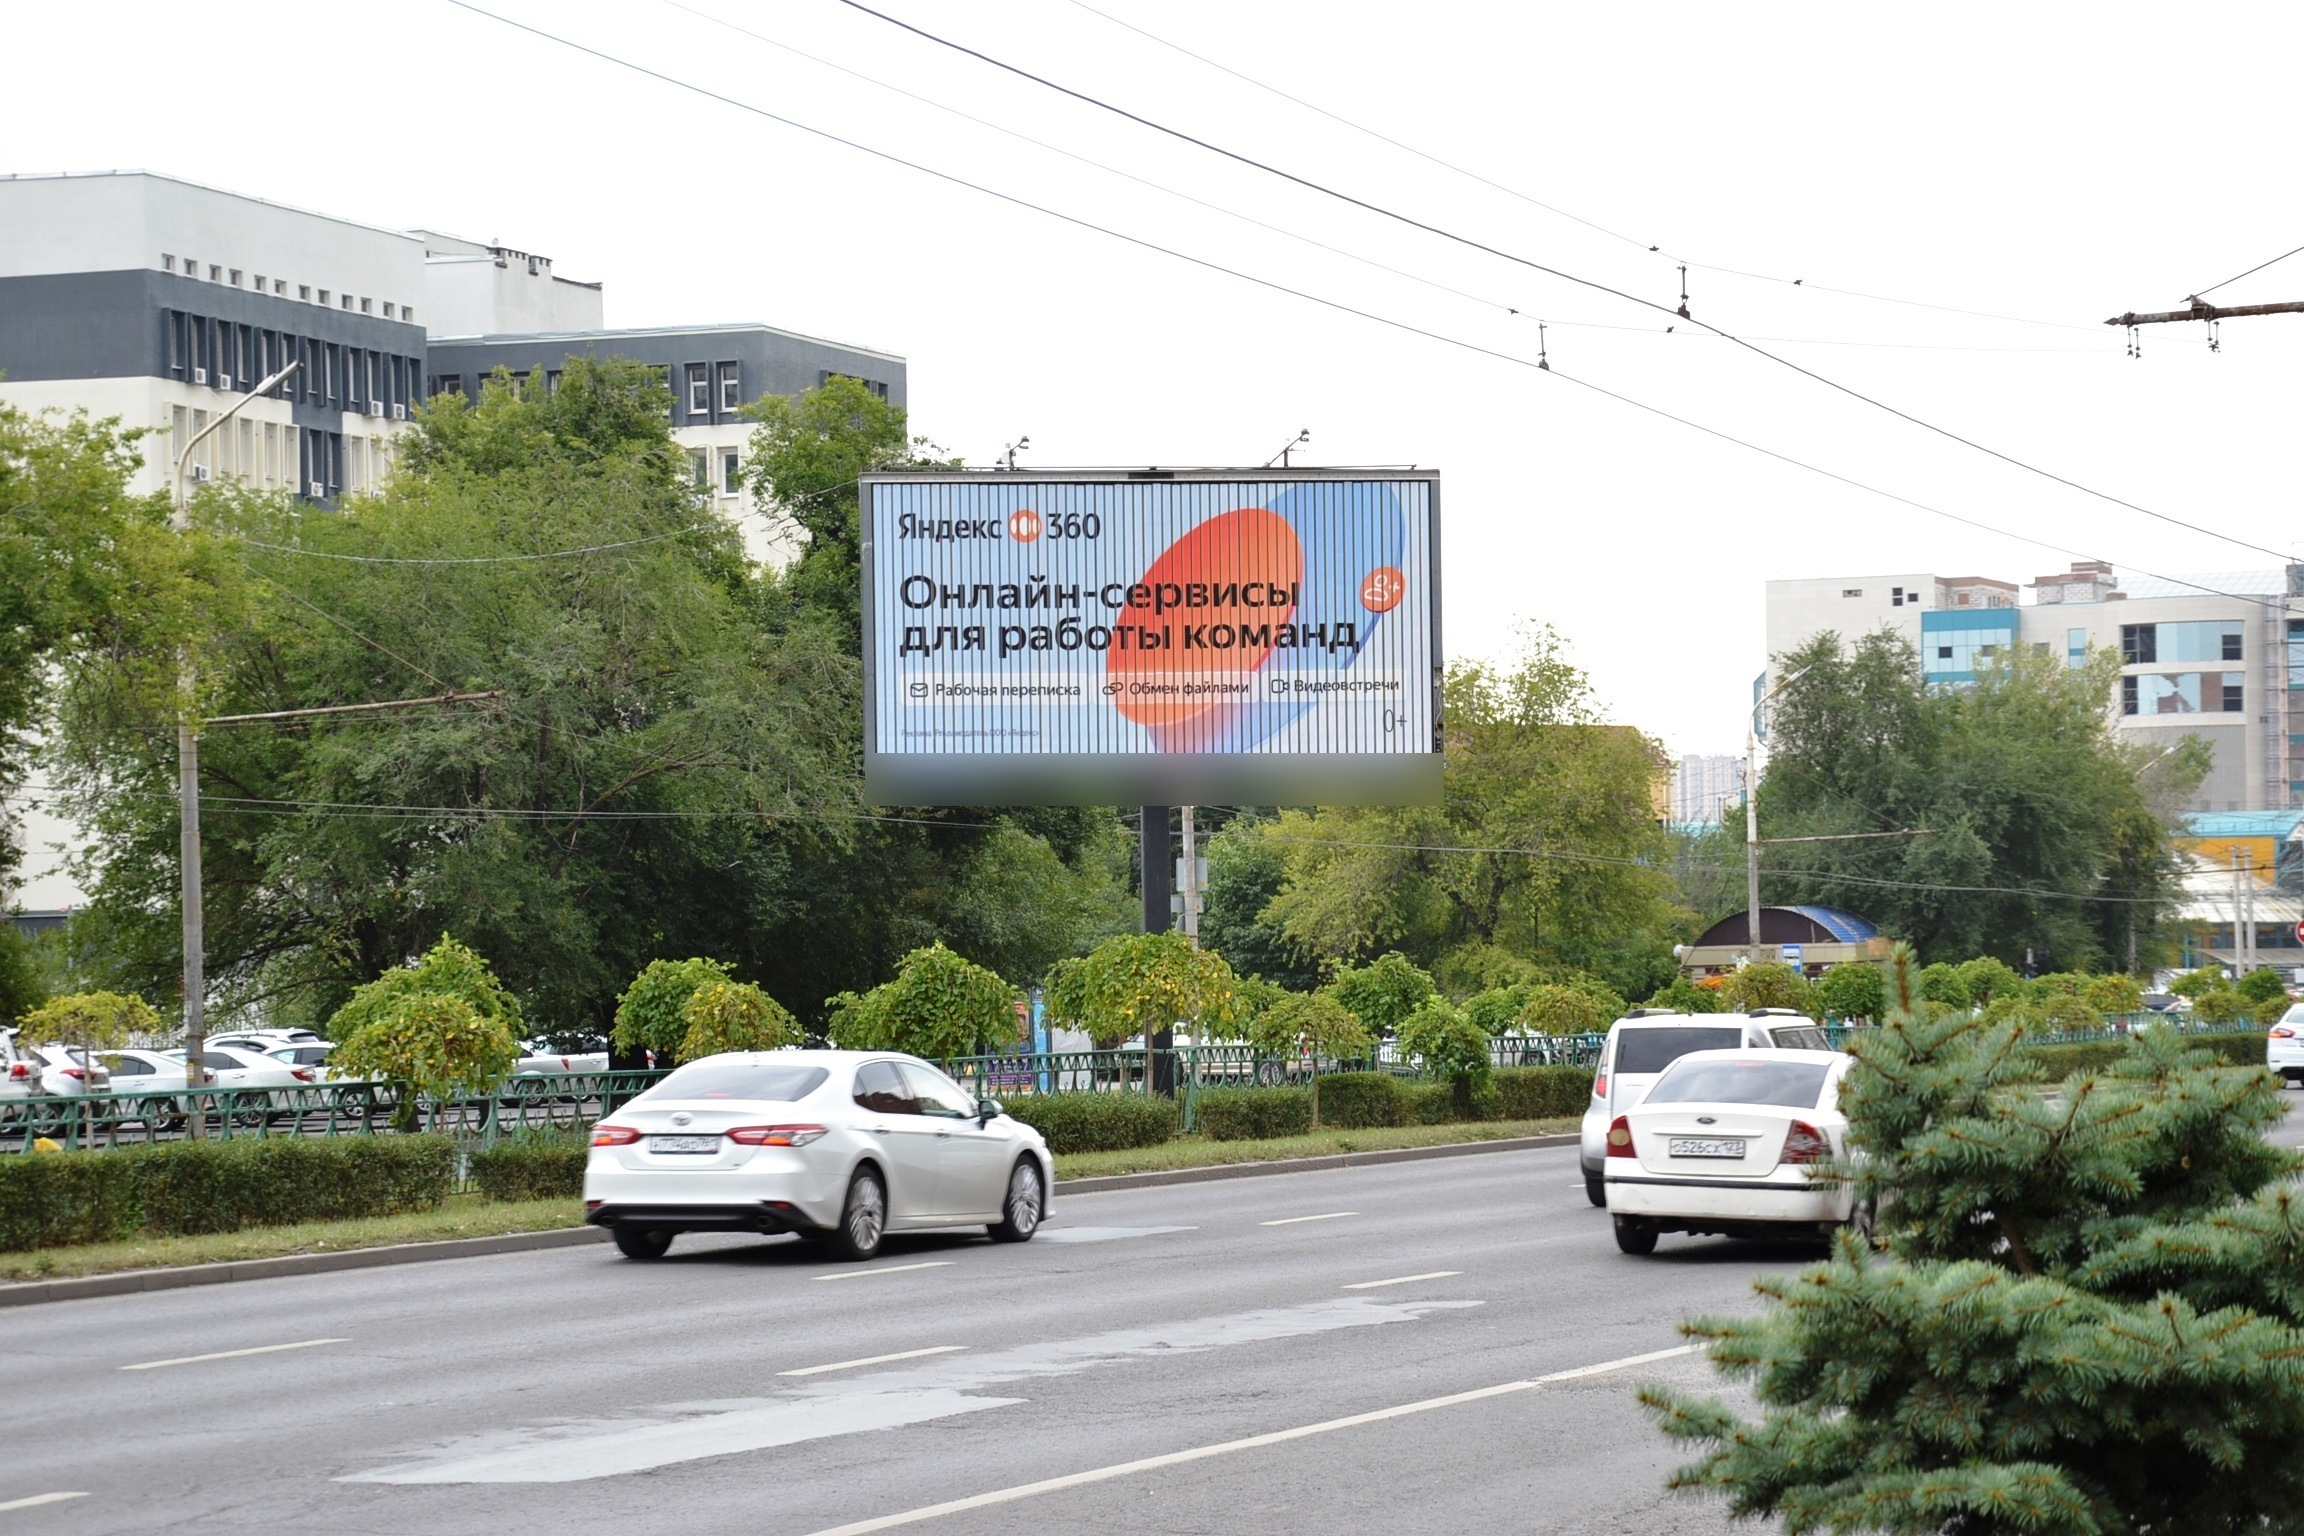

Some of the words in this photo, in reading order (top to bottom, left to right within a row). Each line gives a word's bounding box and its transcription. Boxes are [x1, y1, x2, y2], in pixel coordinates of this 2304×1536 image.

[898, 513, 1002, 543] Яндекс
[1047, 512, 1101, 540] 360
[899, 575, 1300, 615] Онлайн-сервисы
[899, 626, 986, 658] для
[998, 616, 1171, 659] работы
[1184, 622, 1360, 654] команд
[935, 683, 997, 697] Рабочая
[1001, 683, 1081, 699] переписка
[1129, 681, 1179, 695] Обмен
[1183, 680, 1249, 697] файлами
[1294, 679, 1400, 697] Видеовстречи
[1383, 708, 1408, 733] 0+
